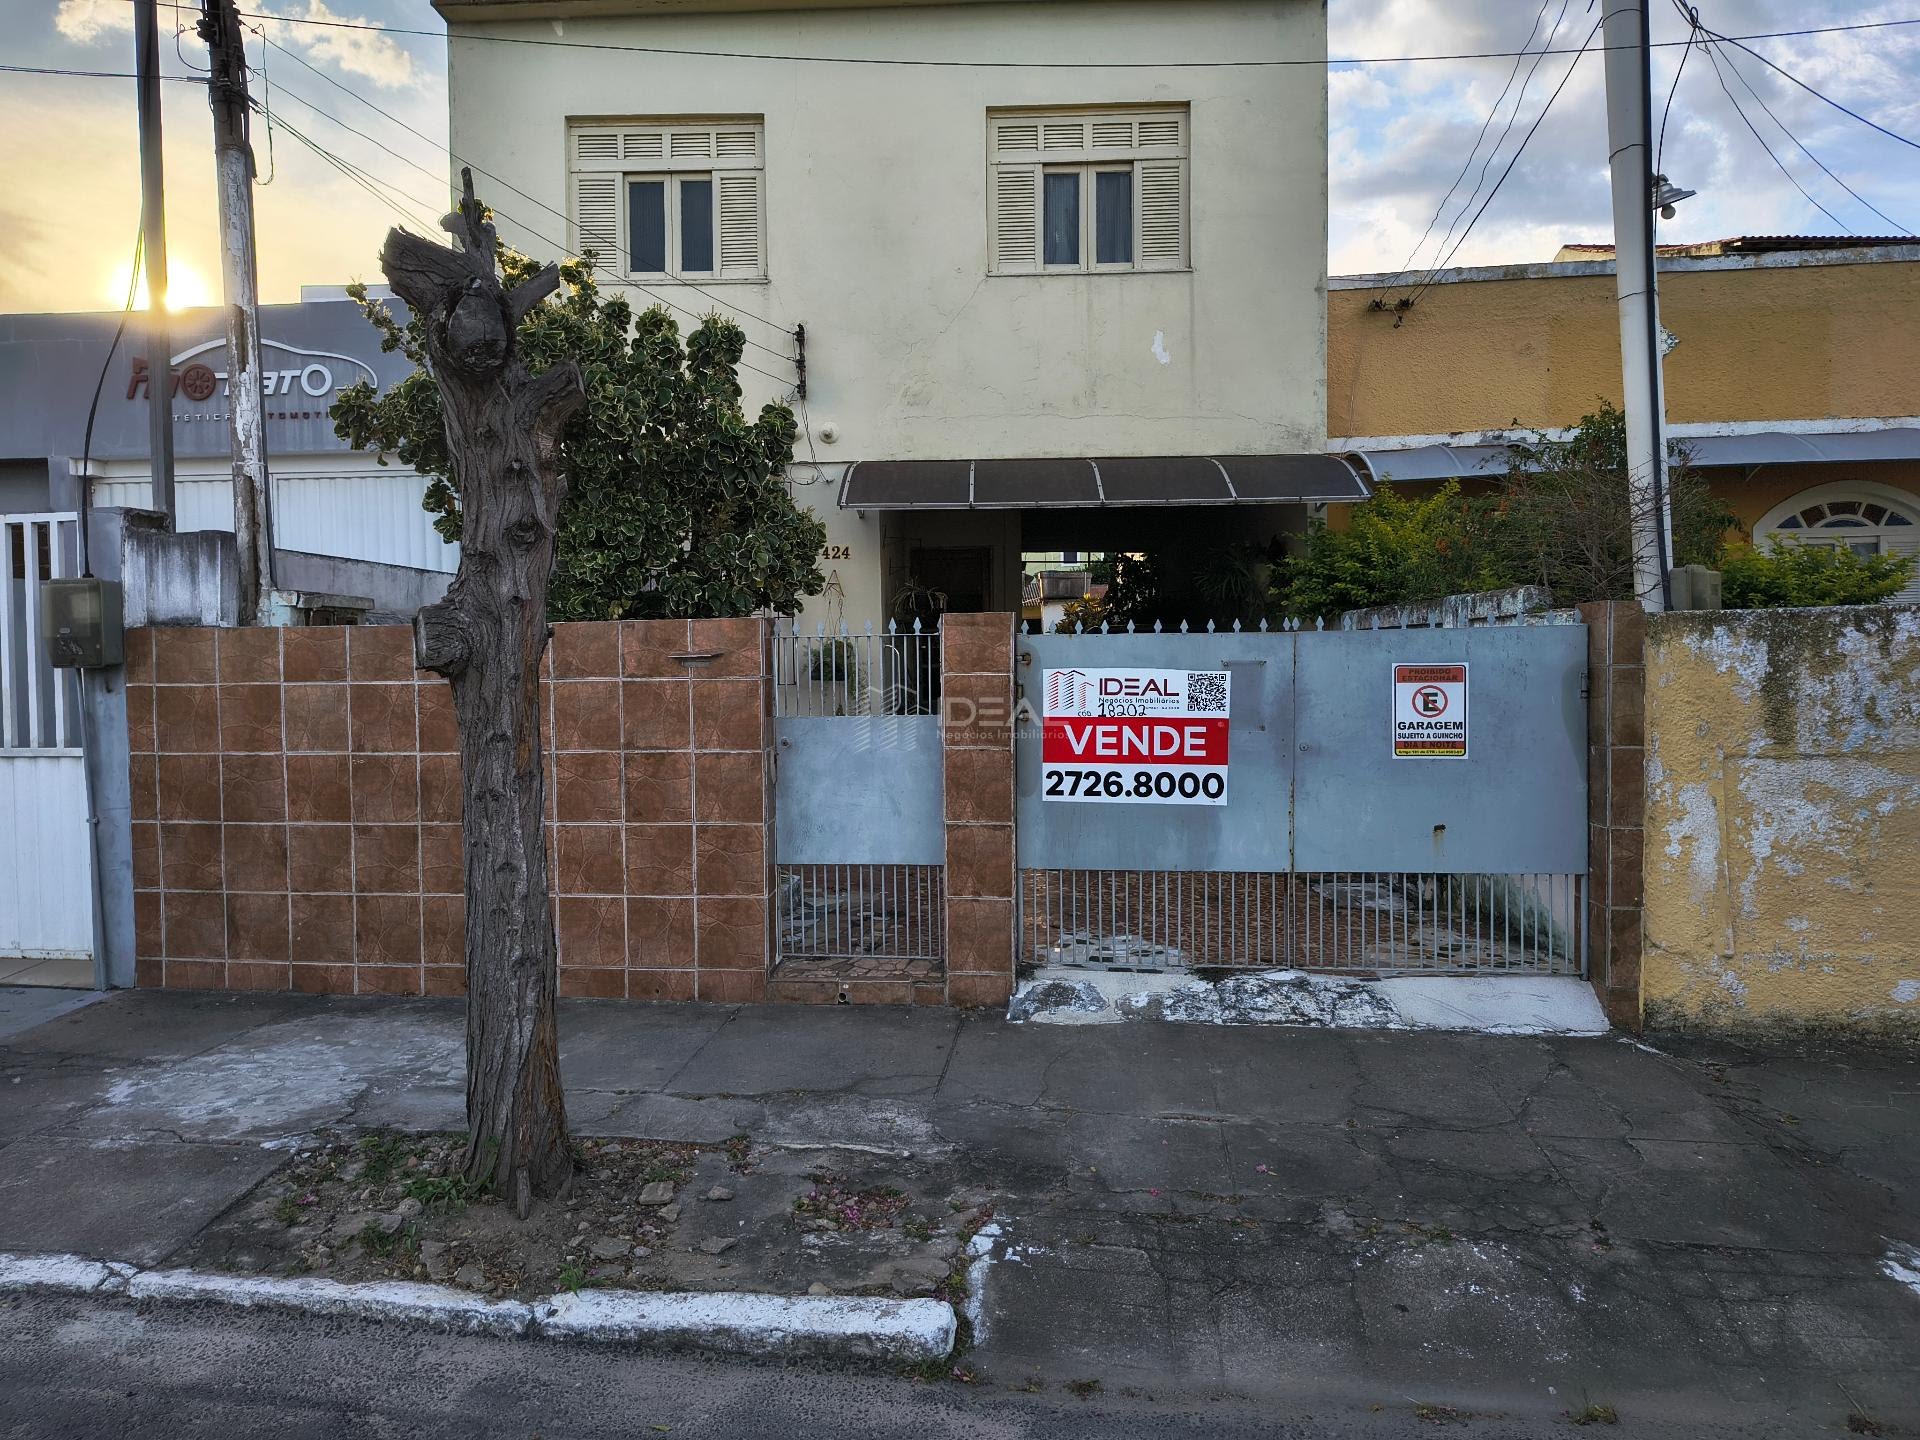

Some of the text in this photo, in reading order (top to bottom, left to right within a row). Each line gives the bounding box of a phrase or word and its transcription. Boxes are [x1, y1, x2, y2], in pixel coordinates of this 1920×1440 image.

[822, 546, 851, 559] 424
[1099, 678, 1180, 696] IDEAL
[1097, 702, 1147, 717] 18202
[1397, 721, 1463, 730] GARAGEM
[1064, 724, 1207, 757] VENDE
[1045, 770, 1225, 799] 2726.8000
